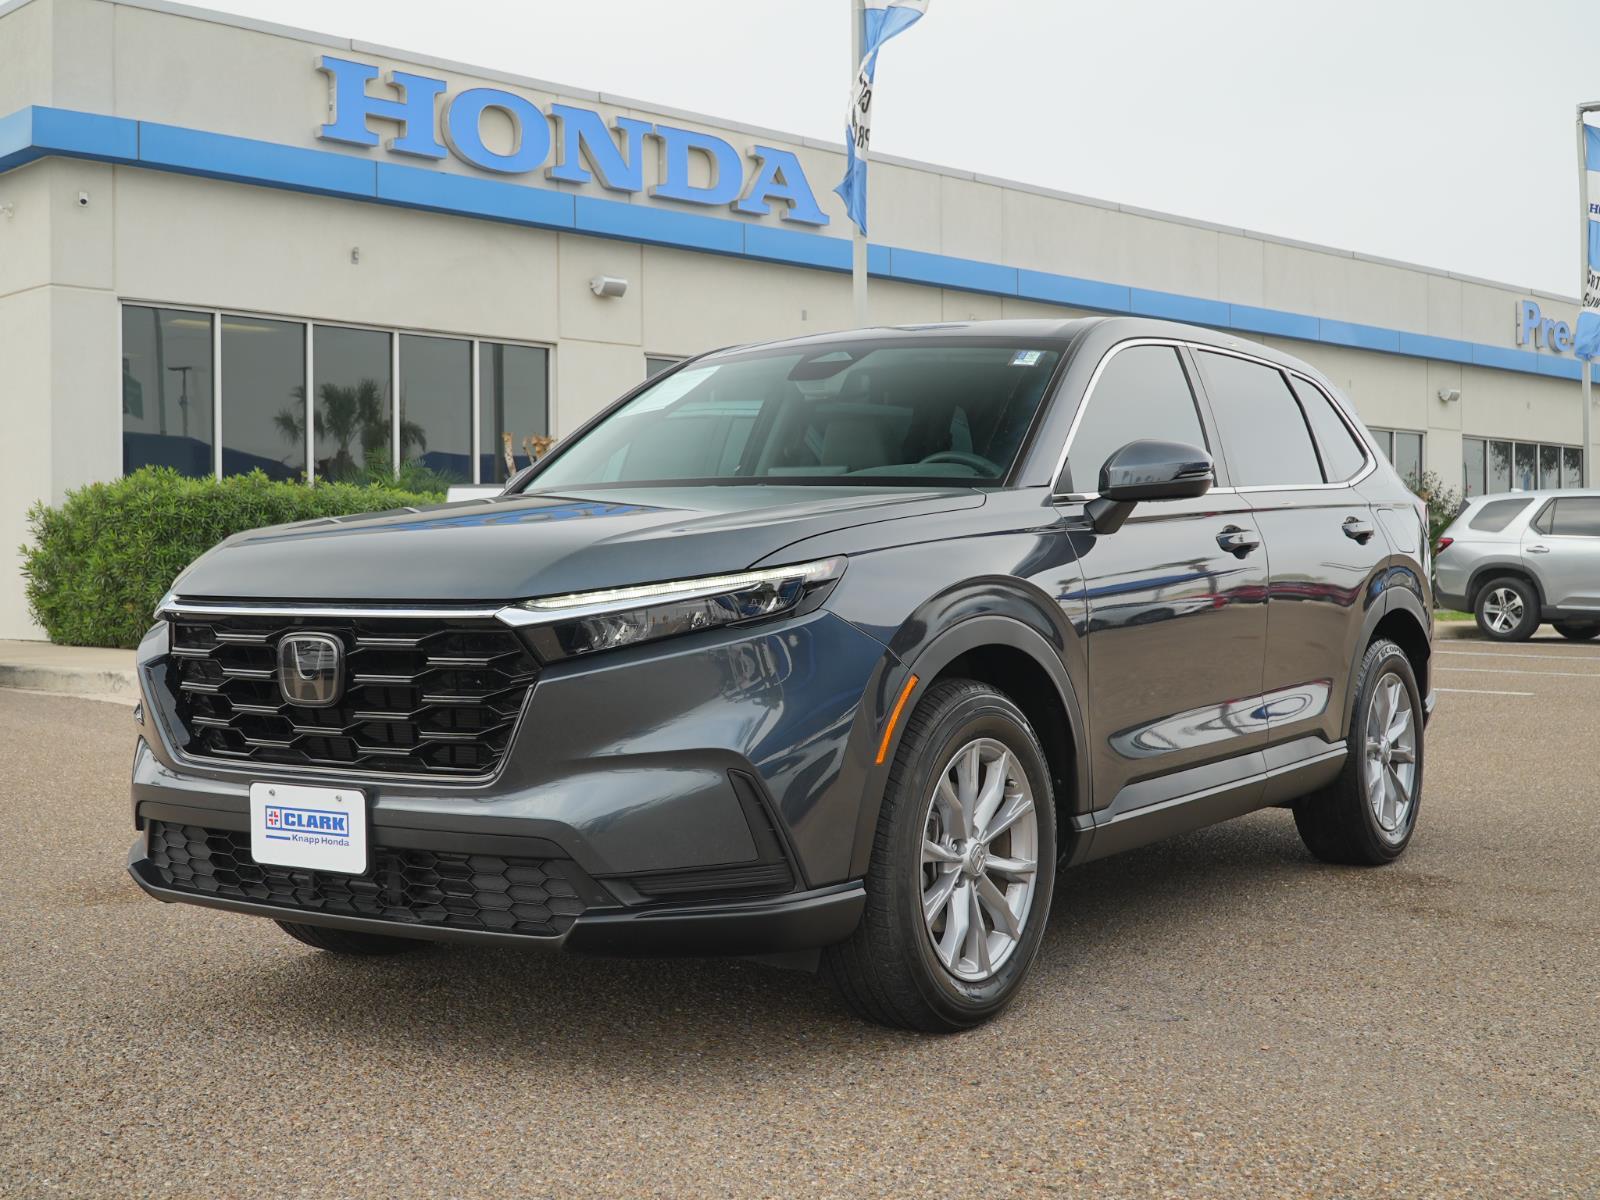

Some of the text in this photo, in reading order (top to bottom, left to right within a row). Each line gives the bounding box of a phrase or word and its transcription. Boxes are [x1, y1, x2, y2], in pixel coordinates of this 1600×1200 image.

[315, 55, 830, 227] HONDA
[284, 812, 345, 831] CLARK
[292, 834, 350, 847] Knapp Honda
